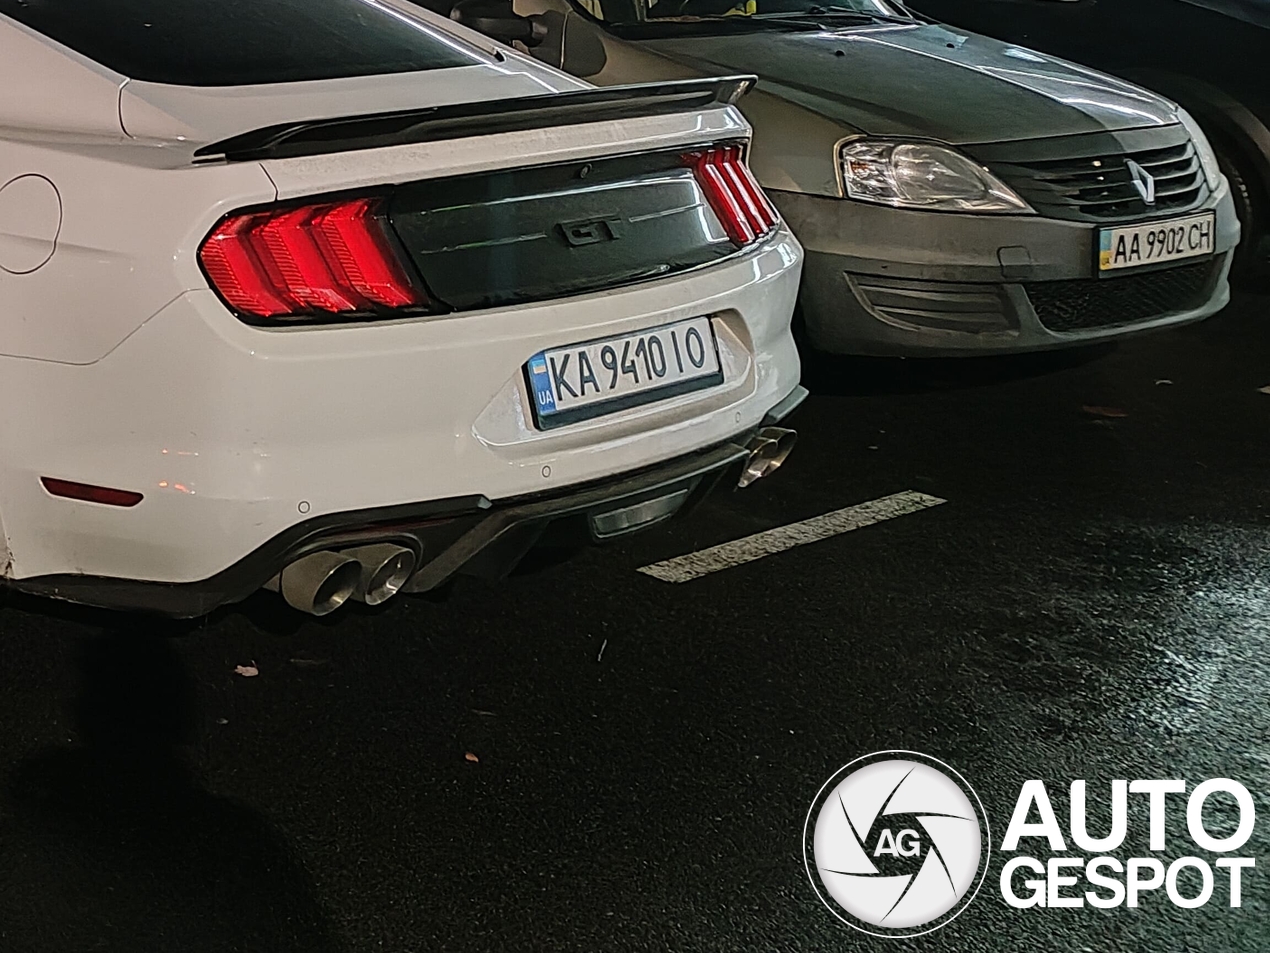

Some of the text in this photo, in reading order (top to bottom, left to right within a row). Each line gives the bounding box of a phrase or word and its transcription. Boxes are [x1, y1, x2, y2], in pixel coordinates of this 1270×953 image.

[555, 216, 621, 246] GT
[1114, 221, 1211, 264] AA 9902 CH
[549, 350, 600, 401] KA
[601, 335, 667, 389] 9410
[538, 391, 554, 405] UA
